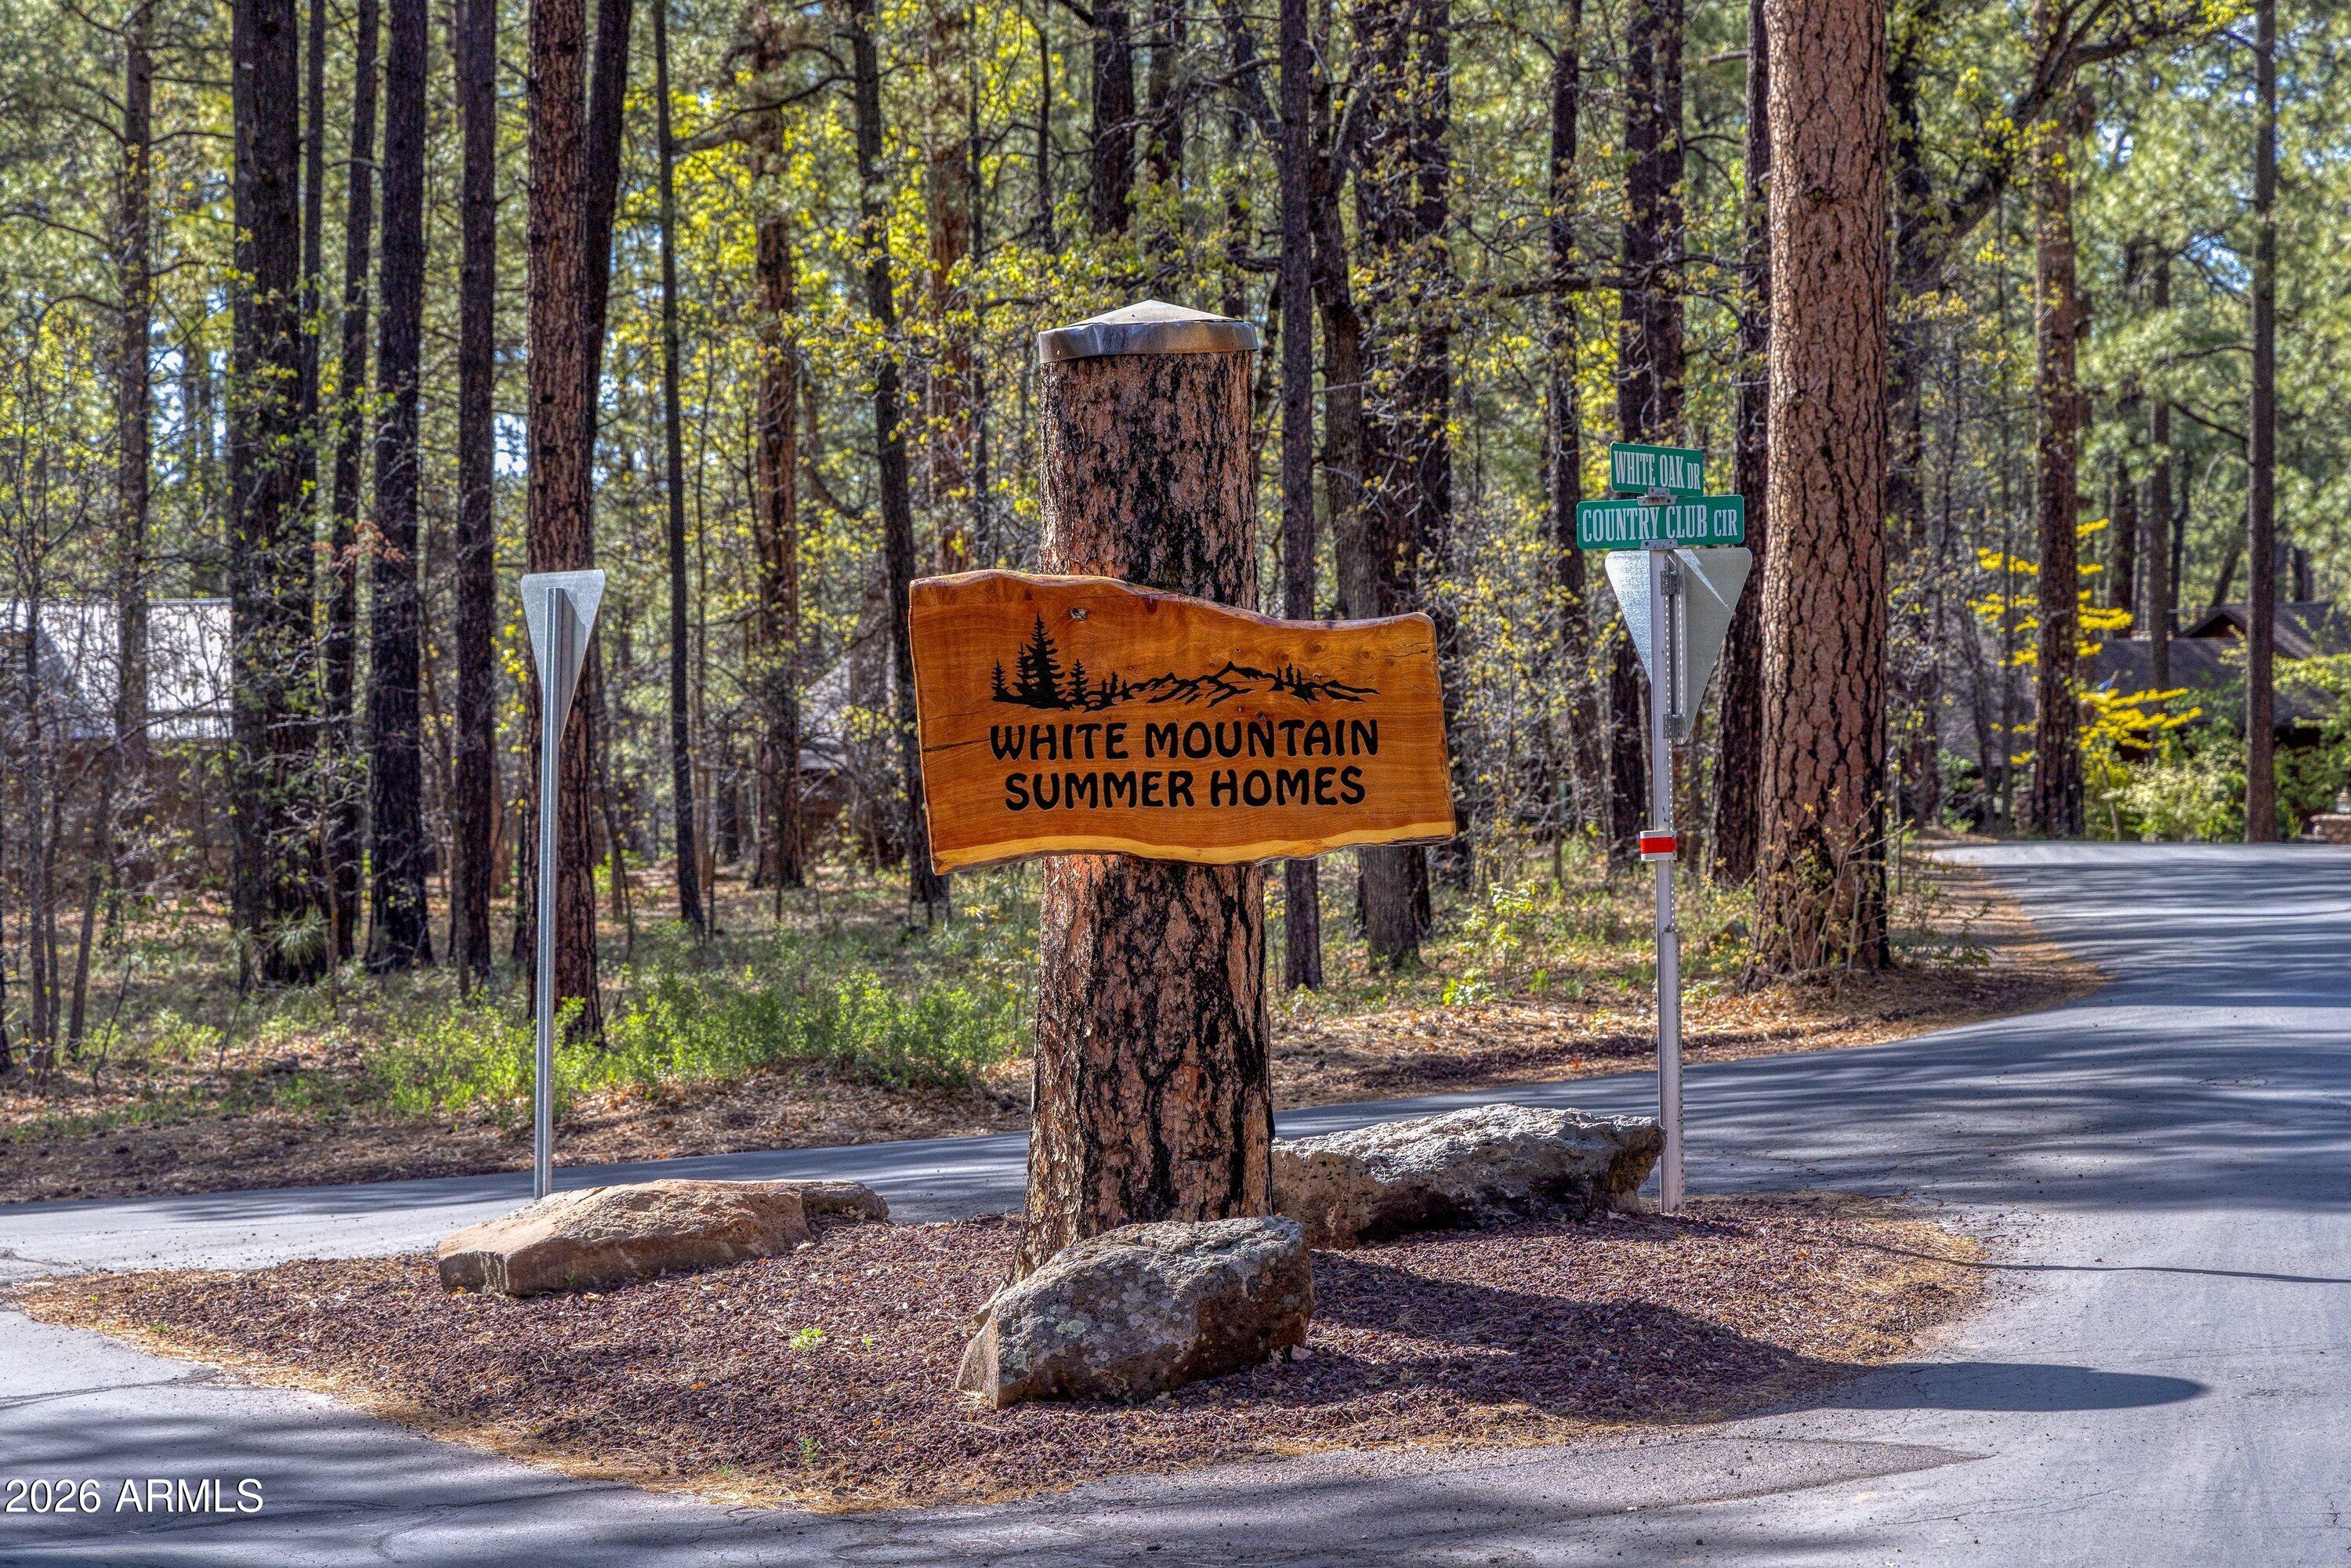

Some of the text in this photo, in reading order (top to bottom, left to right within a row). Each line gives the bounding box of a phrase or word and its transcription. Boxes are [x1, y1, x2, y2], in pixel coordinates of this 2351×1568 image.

[1613, 451, 1701, 490] WHITE OAK DR
[1582, 504, 1738, 542] COUNTRY CLUB CIR
[990, 719, 1378, 761] WHITE MOUNTAIN
[1005, 765, 1366, 812] SUMMER HOMES
